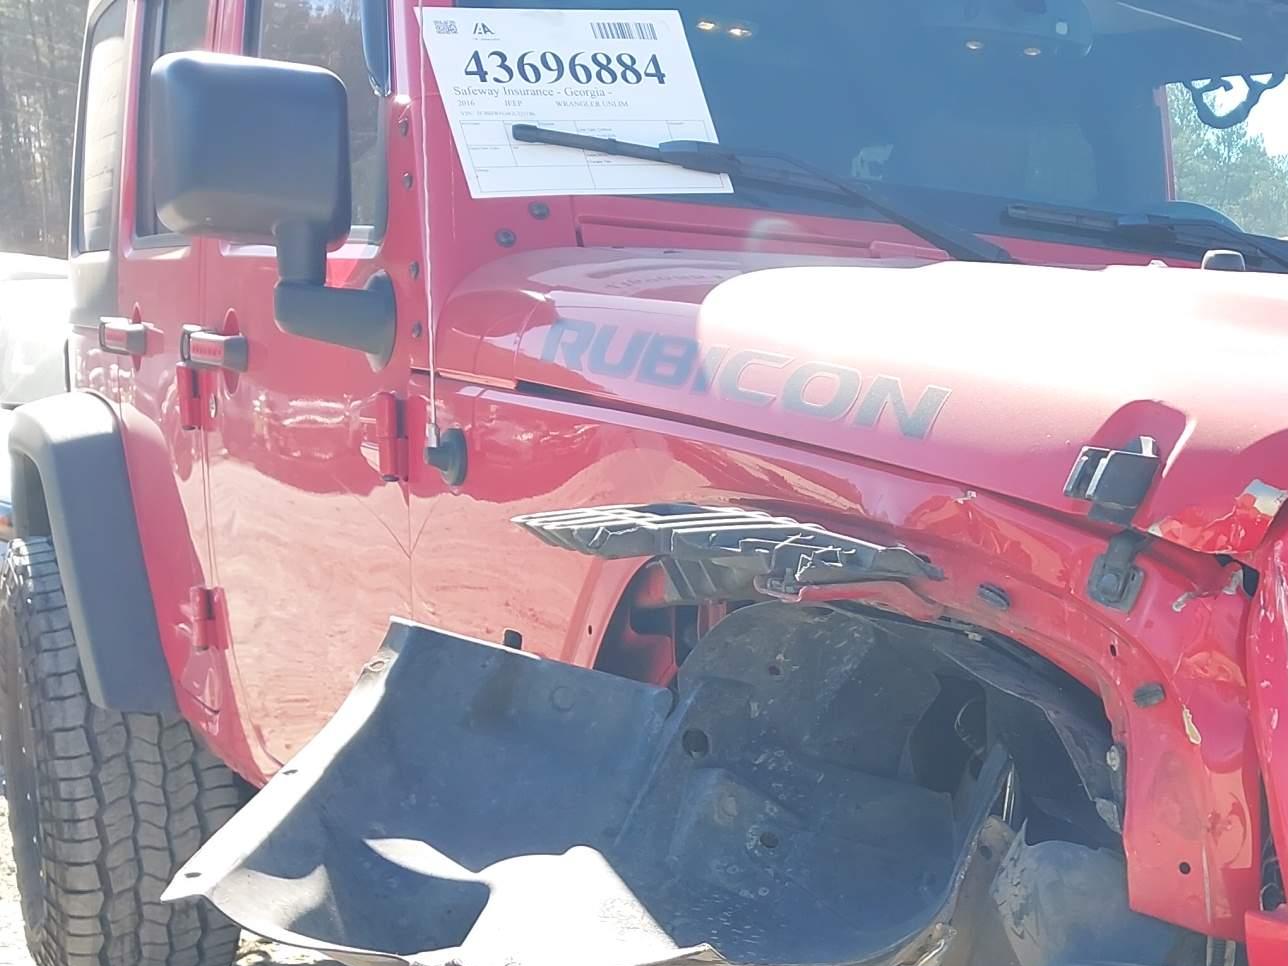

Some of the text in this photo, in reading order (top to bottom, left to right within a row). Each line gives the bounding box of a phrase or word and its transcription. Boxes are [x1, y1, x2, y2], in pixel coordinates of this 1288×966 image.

[464, 49, 666, 85] 43696884
[453, 86, 500, 98] Safeway
[503, 86, 554, 97] Insurance
[564, 87, 606, 99] Georgia
[457, 99, 476, 107] 2016
[541, 318, 952, 440] RUBICON
